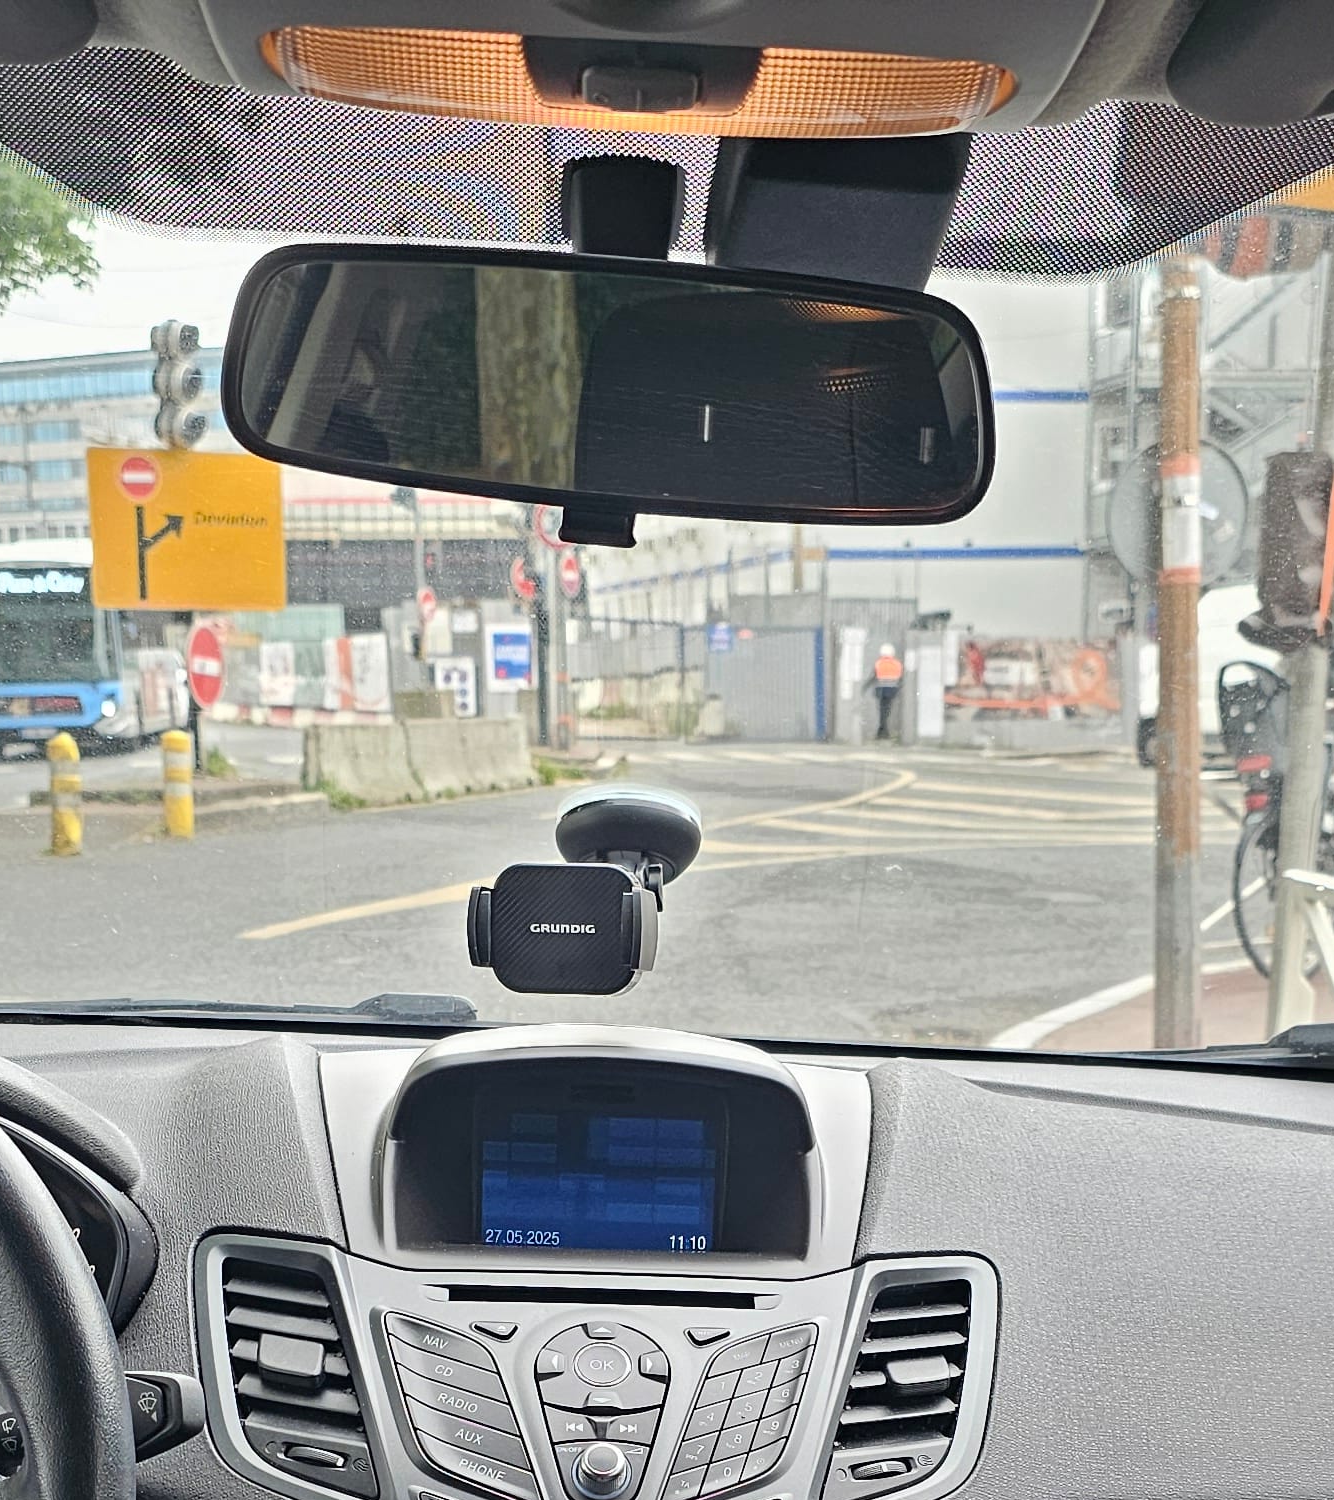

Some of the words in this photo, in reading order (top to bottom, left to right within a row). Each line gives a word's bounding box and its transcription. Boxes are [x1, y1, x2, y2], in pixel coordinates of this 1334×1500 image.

[529, 923, 596, 934] GRUNDIG
[485, 1228, 560, 1246] 27.05.2025
[669, 1235, 706, 1250] 11:10
[422, 1334, 449, 1350] NAV
[434, 1364, 454, 1378] CD
[589, 1359, 615, 1371] OK
[754, 1371, 763, 1380] 2
[791, 1359, 800, 1369] 3
[437, 1392, 479, 1414] RADIO
[706, 1412, 715, 1421] 4
[744, 1402, 753, 1412] 5
[781, 1388, 790, 1398] 6
[454, 1428, 484, 1445] AUX
[696, 1445, 705, 1454] 7
[734, 1434, 743, 1444] 8
[771, 1420, 780, 1430] 9
[459, 1458, 507, 1482] PHONE
[723, 1467, 732, 1477] 0
